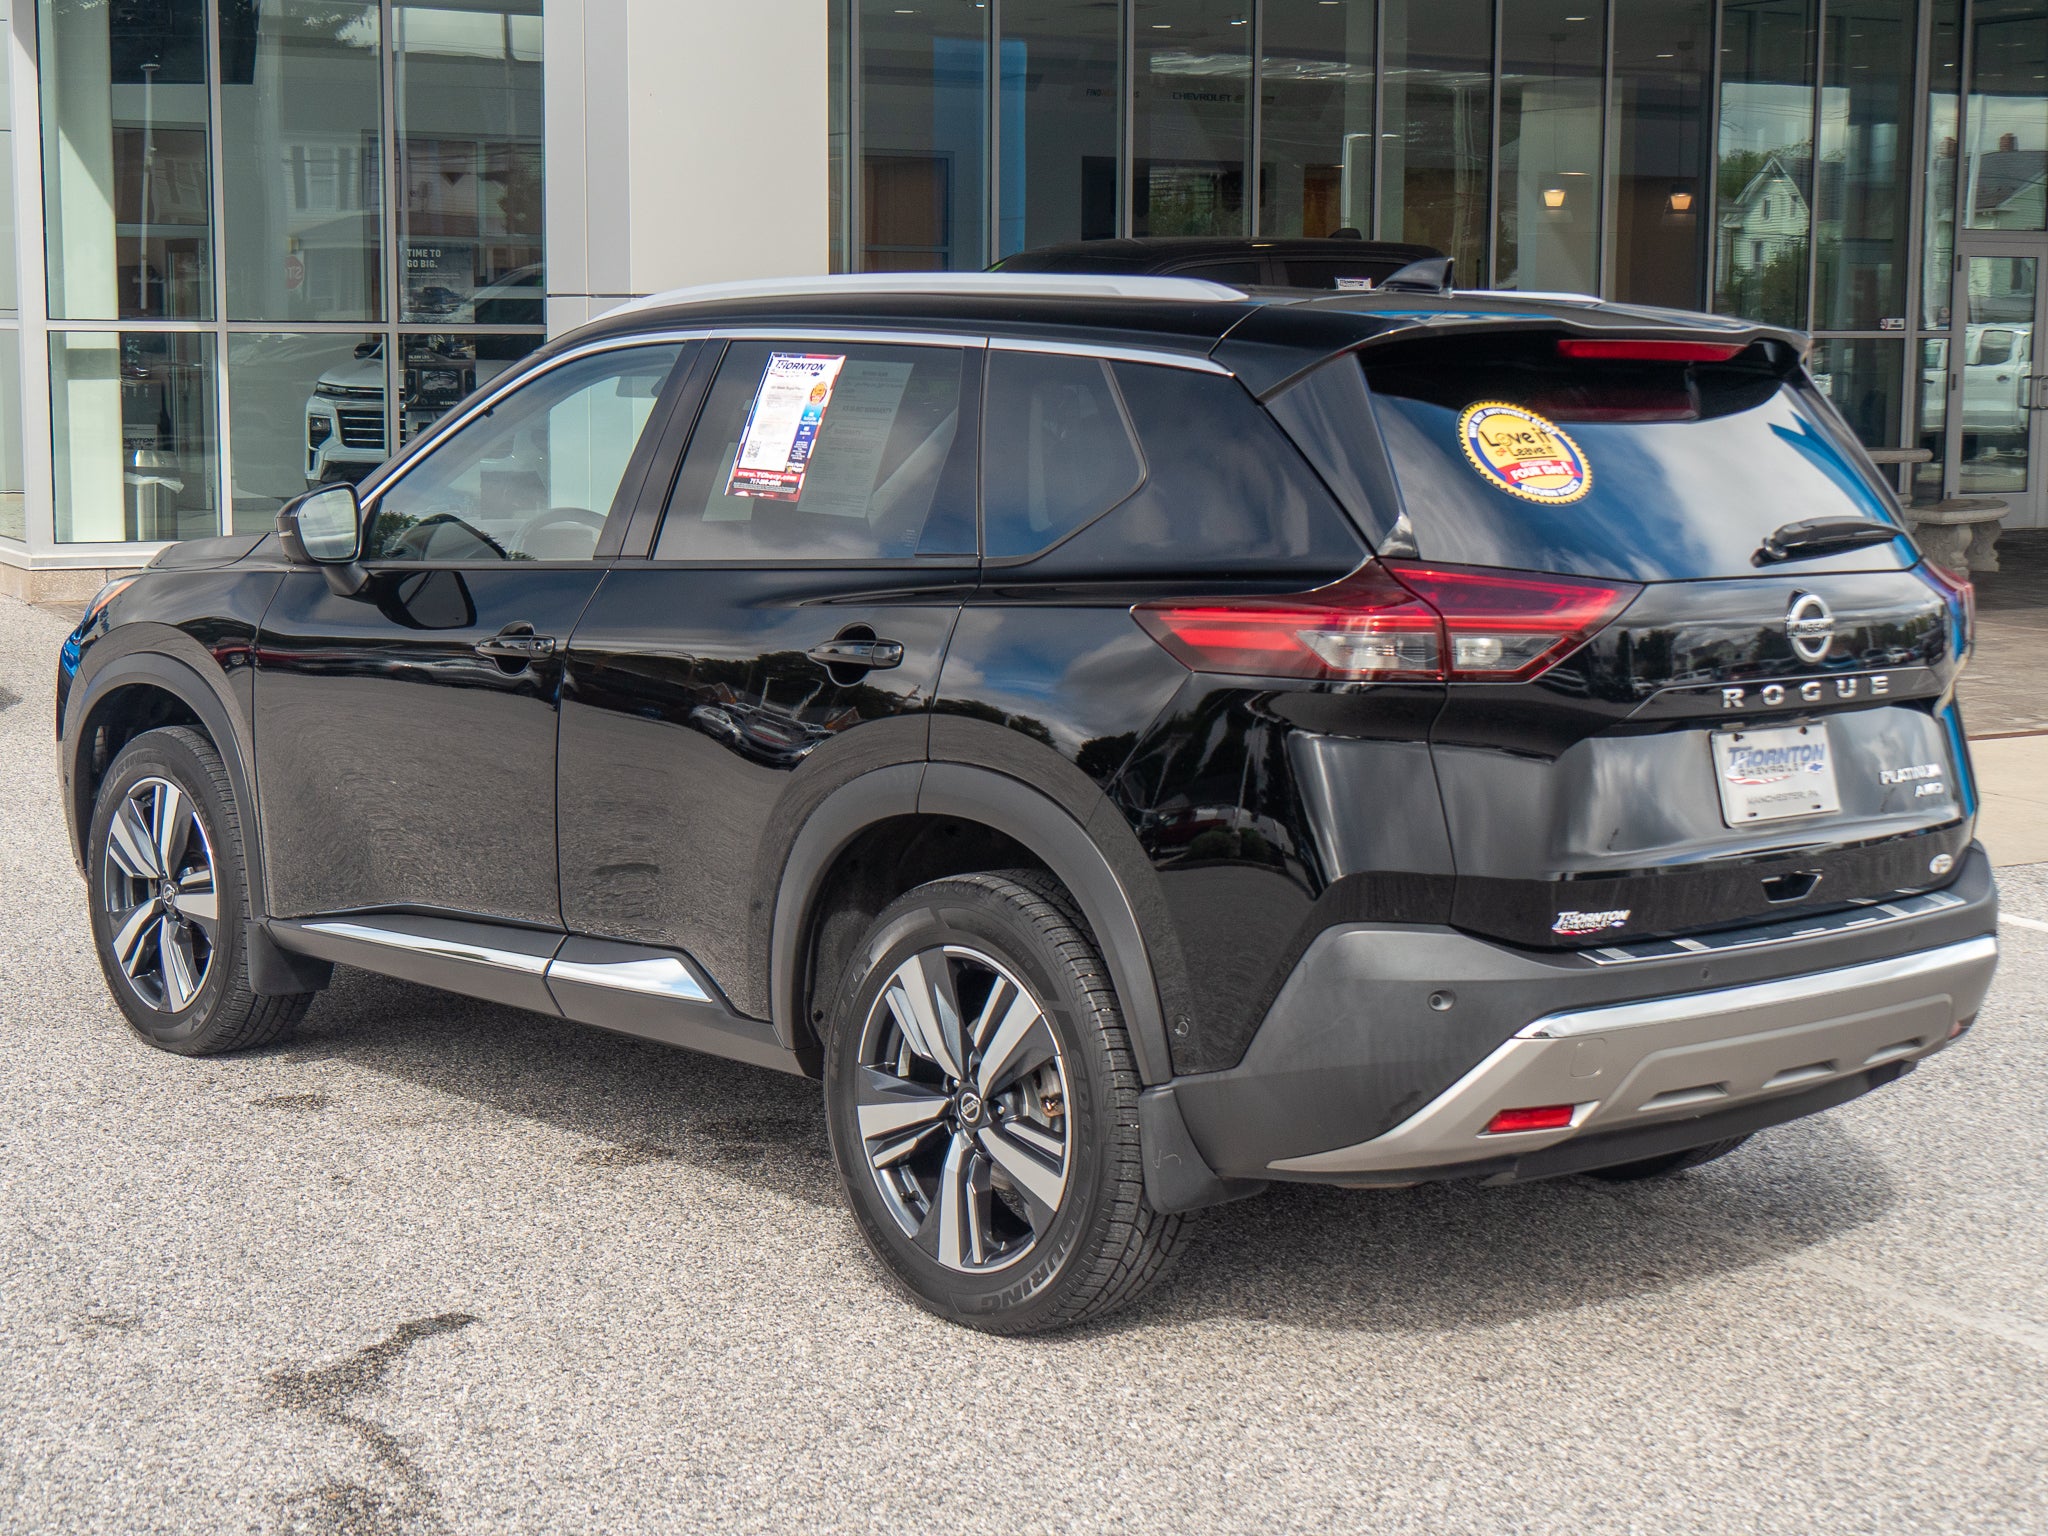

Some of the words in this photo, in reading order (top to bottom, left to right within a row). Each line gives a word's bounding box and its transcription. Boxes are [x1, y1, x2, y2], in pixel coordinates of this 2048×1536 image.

[1172, 92, 1232, 102] CHEVROLET
[406, 248, 428, 258] TIME
[429, 248, 442, 258] TO
[406, 259, 419, 268] GO
[420, 259, 438, 268] BIG.
[776, 359, 826, 371] THORNTON
[1479, 430, 1535, 447] Love
[1531, 427, 1552, 443] it
[1506, 445, 1546, 457] Leave
[1509, 466, 1544, 481] FOUR
[1721, 675, 1890, 708] ROGUE
[1727, 743, 1825, 767] THORNTON
[1880, 764, 1941, 785] PLATINUM
[1914, 782, 1945, 798] AWD
[1556, 909, 1631, 928] THORNTON
